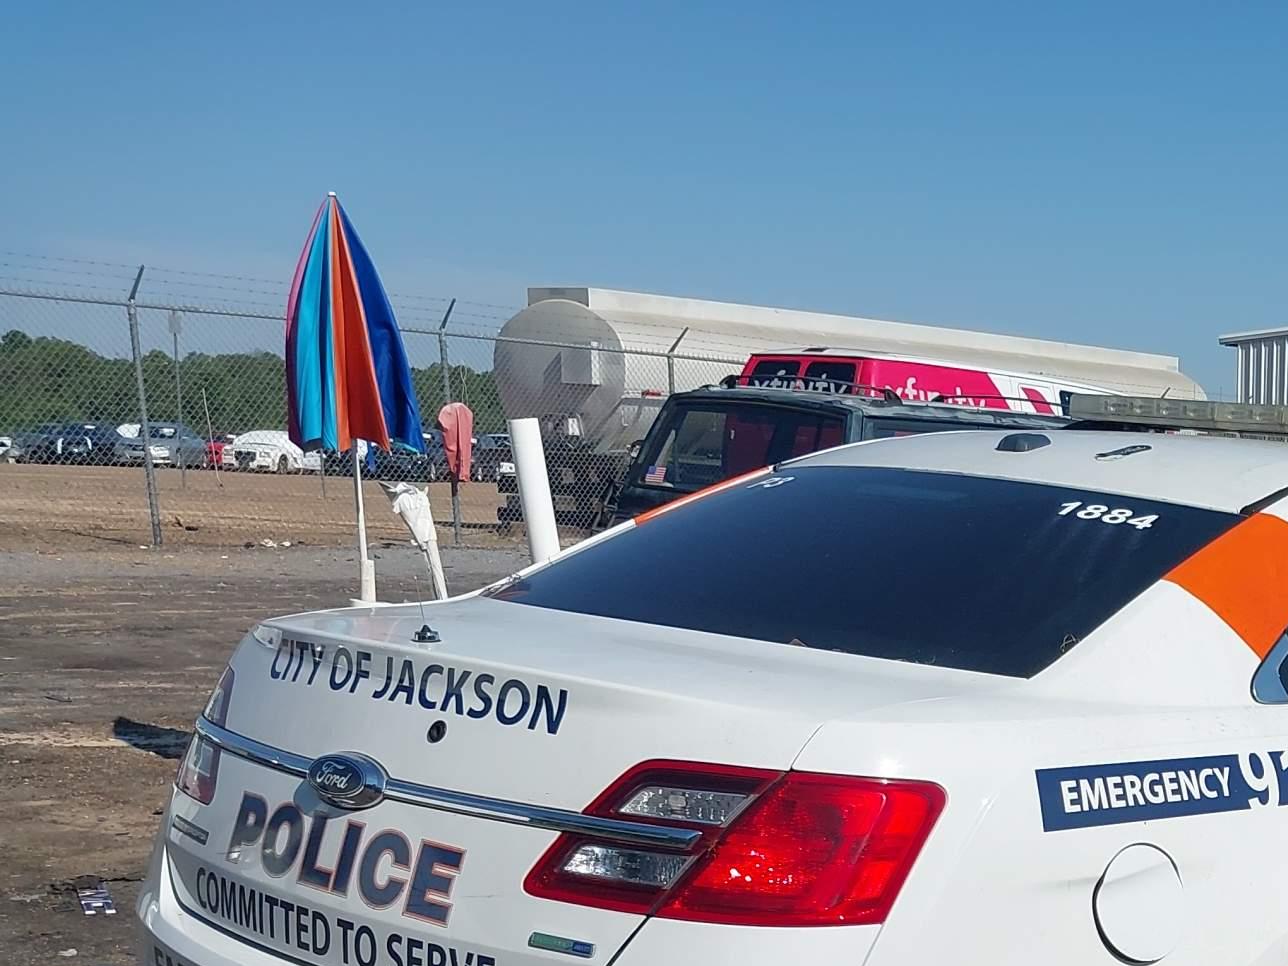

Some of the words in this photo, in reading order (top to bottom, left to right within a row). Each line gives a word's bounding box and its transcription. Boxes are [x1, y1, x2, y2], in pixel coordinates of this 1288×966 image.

[1056, 501, 1161, 530] 1884
[269, 638, 323, 682] CITY
[329, 646, 372, 691] OF
[374, 656, 569, 736] JACKSON
[316, 761, 353, 789] Ford
[1059, 767, 1235, 814] EMERGENCY
[226, 791, 467, 927] POLICE
[195, 866, 331, 957] COMMITTED
